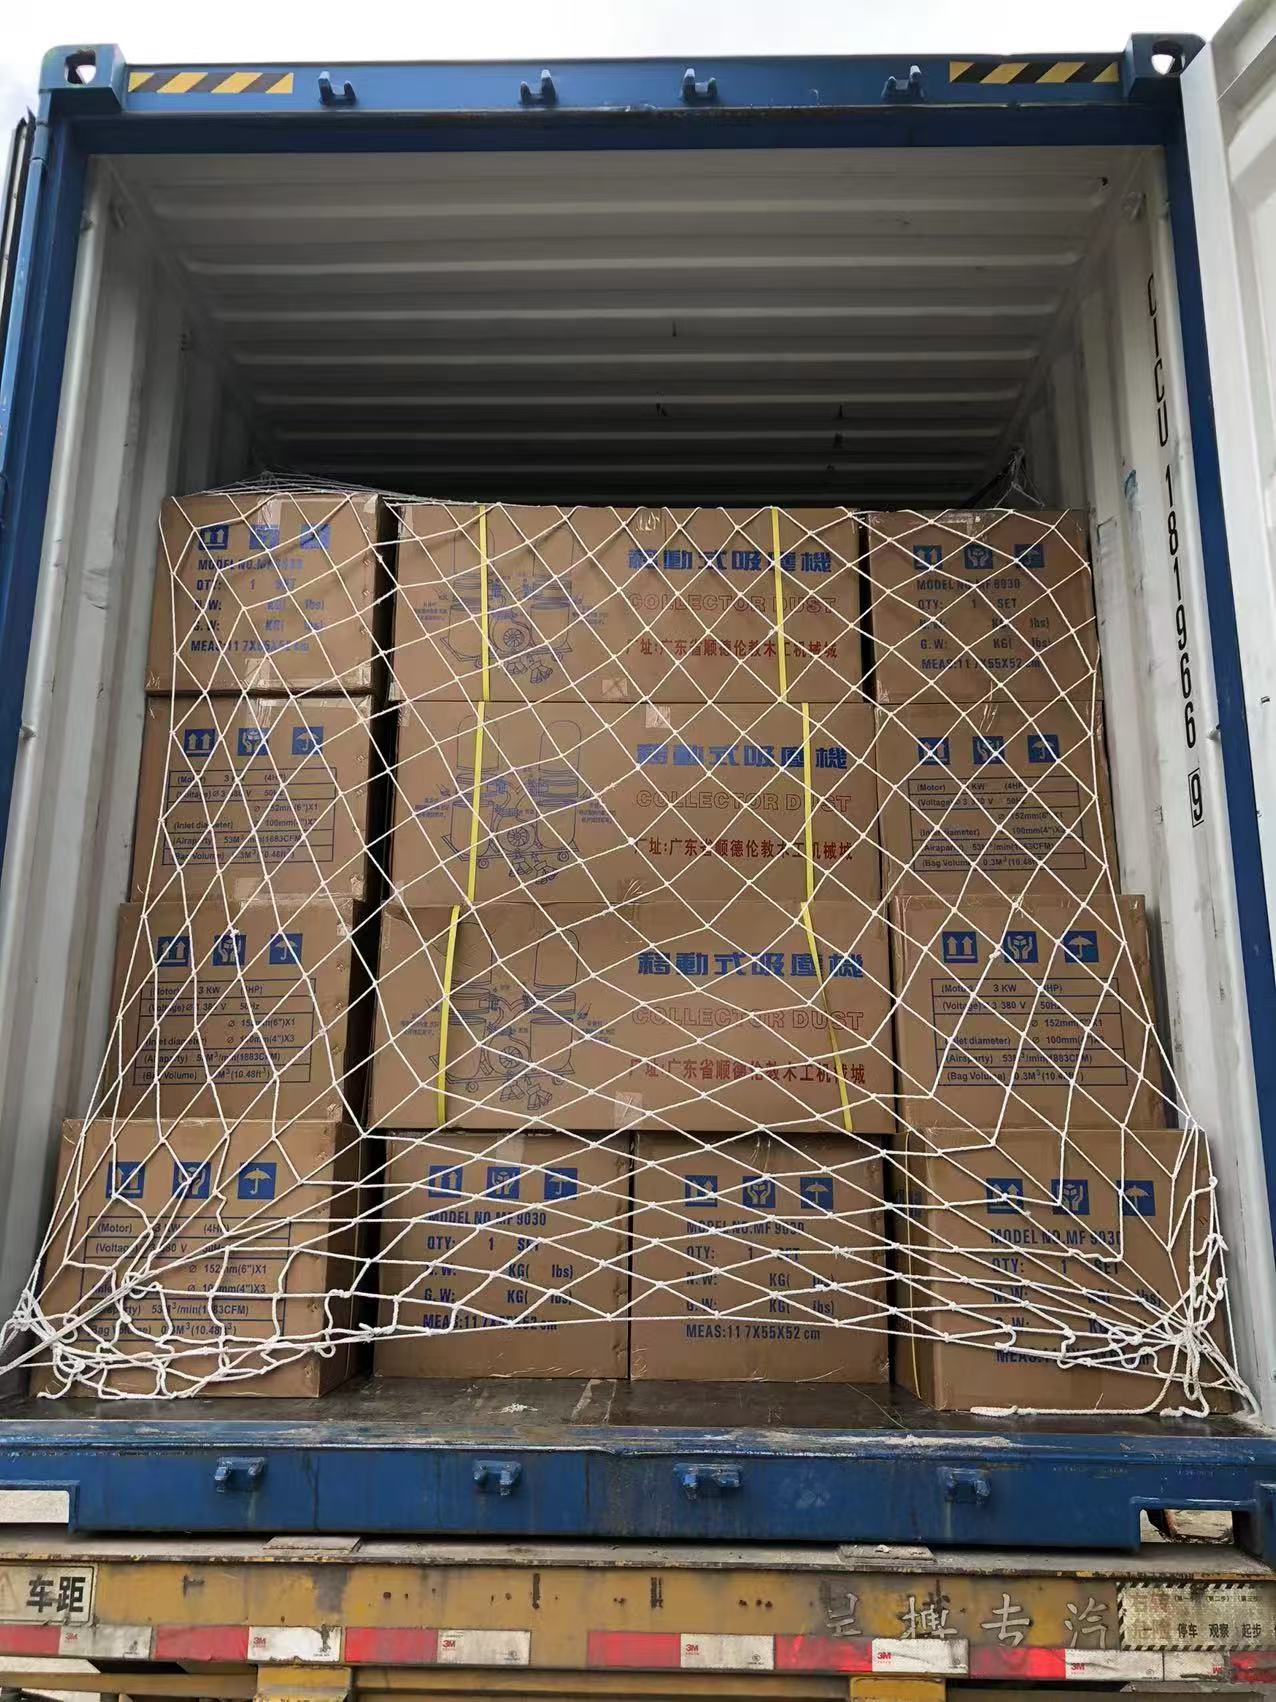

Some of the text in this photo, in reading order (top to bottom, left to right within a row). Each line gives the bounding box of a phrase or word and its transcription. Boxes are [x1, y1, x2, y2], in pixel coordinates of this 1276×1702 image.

[1148, 274, 1169, 447] CICU
[1165, 464, 1197, 748] 181966
[636, 790, 779, 811] COLLECTOR
[240, 985, 262, 995] (HP)
[993, 984, 999, 992] 3
[1002, 984, 1017, 992] KW
[792, 1009, 863, 1031] DUST
[516, 1212, 546, 1226] 9030
[97, 1223, 132, 1234] (Motor)
[990, 1228, 1039, 1244] MODEL
[159, 1243, 176, 1252] 80
[180, 1243, 188, 1252] V
[686, 1246, 715, 1260] QTY:
[804, 1328, 820, 1340] cm
[26, 1574, 86, 1613] 车距
[1177, 1623, 1198, 1639] 停车
[1208, 1623, 1229, 1639] 观察
[1241, 1623, 1261, 1639] 起步
[253, 1636, 267, 1645] 3M
[442, 1639, 457, 1648] 3M
[685, 1643, 699, 1652] 3M
[877, 1651, 892, 1660] 3M
[1070, 1662, 1085, 1671] 3M
